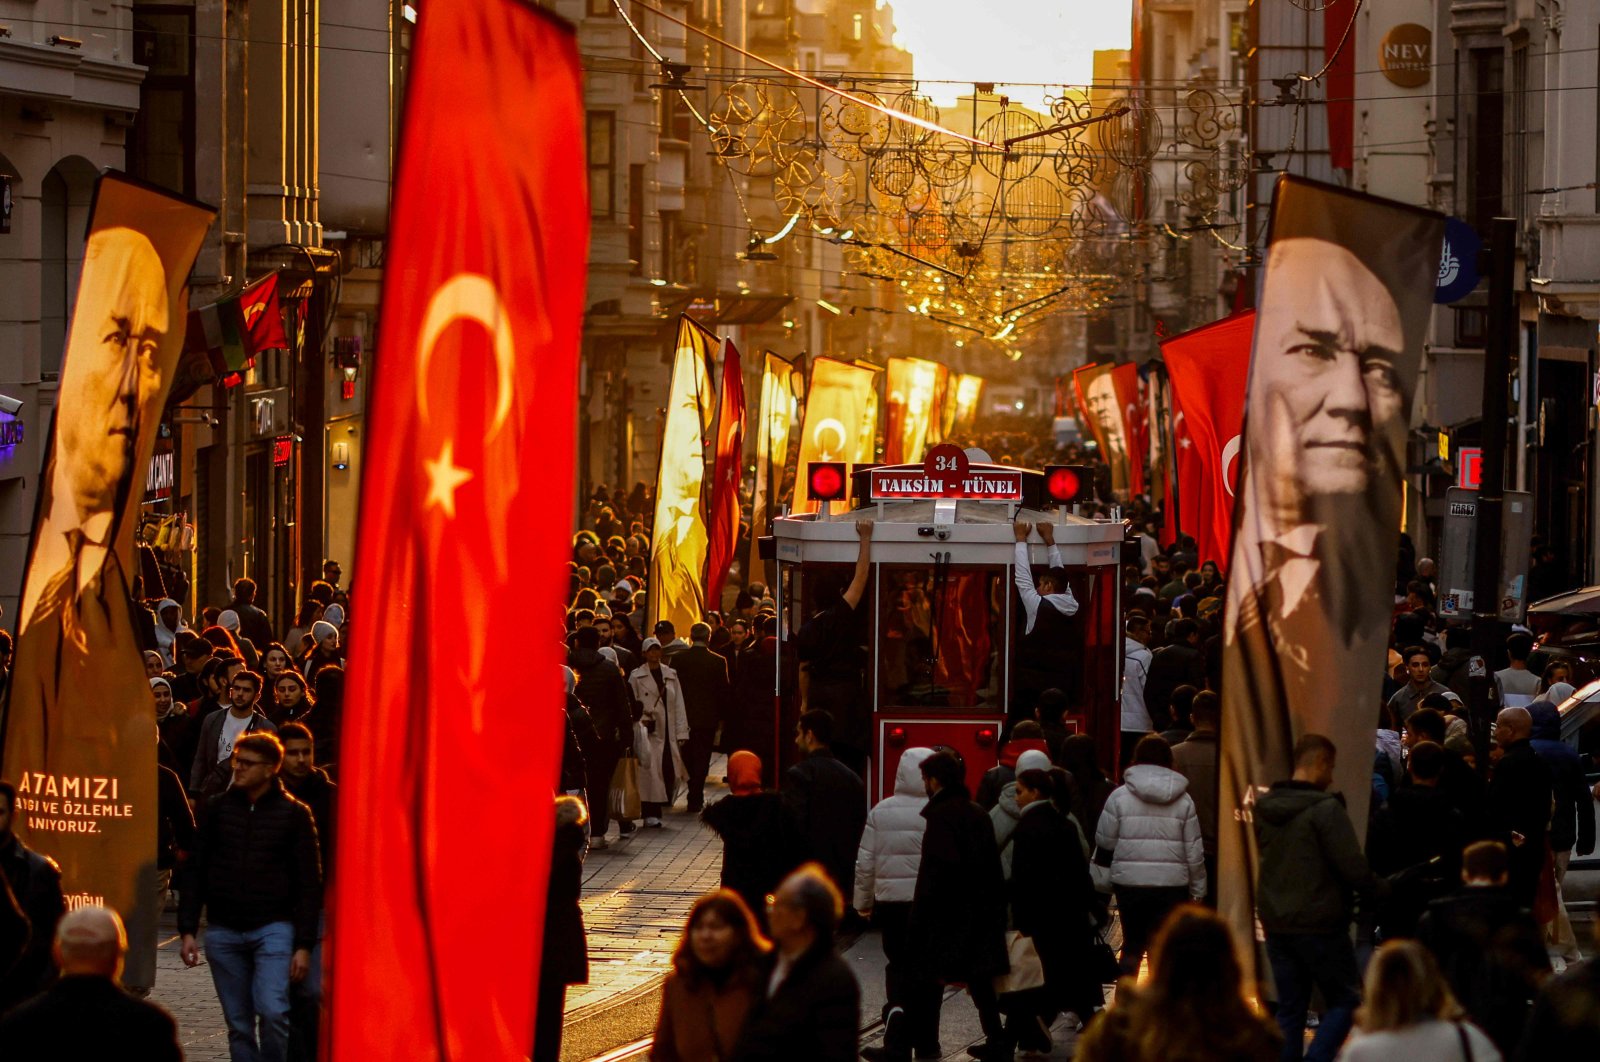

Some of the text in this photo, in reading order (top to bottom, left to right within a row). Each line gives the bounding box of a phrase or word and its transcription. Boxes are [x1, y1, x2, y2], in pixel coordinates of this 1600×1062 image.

[935, 455, 958, 471] 34
[878, 475, 944, 493] TAKSİM
[962, 476, 1017, 494] TÜNEL
[19, 771, 118, 800] ATAMIZI
[15, 797, 133, 817] AYGI VE ÖZLEMLE
